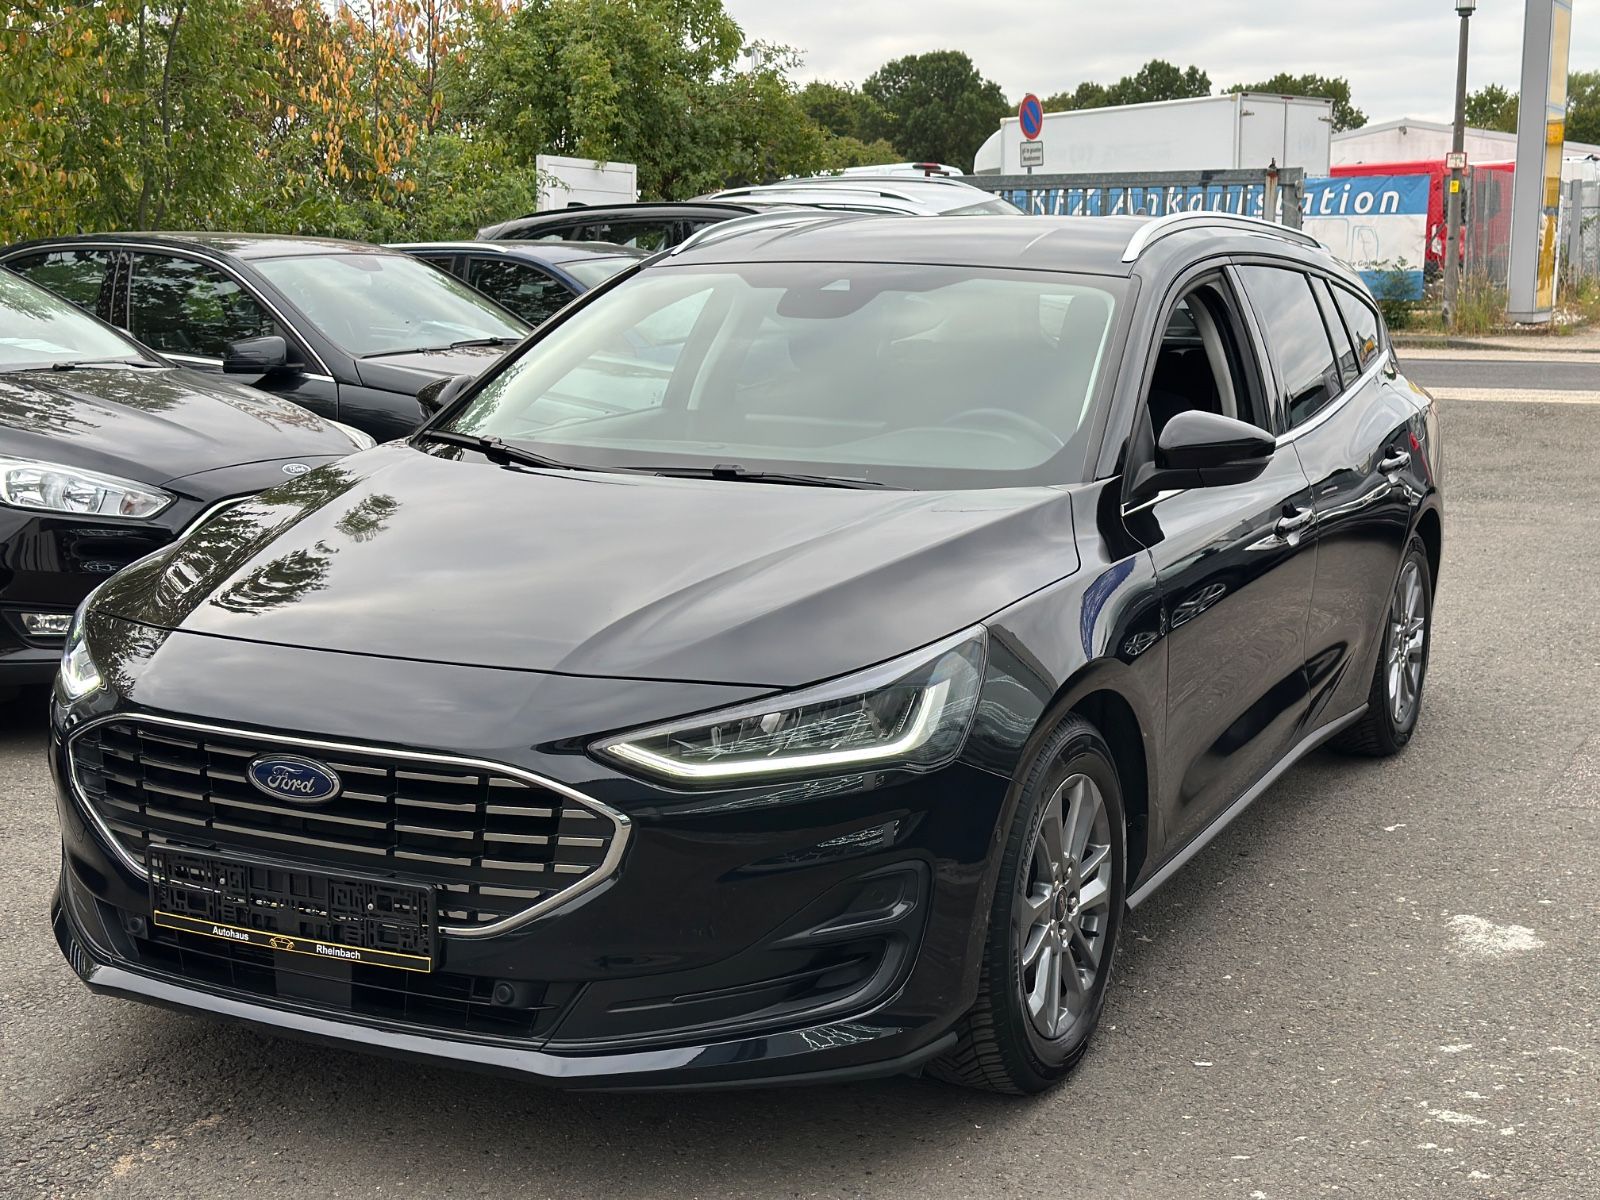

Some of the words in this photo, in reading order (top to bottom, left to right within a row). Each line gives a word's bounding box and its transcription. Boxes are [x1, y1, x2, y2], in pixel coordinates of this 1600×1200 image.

[267, 765, 316, 793] Ford
[212, 926, 249, 941] Autohaus
[316, 944, 361, 960] Rheinbach
